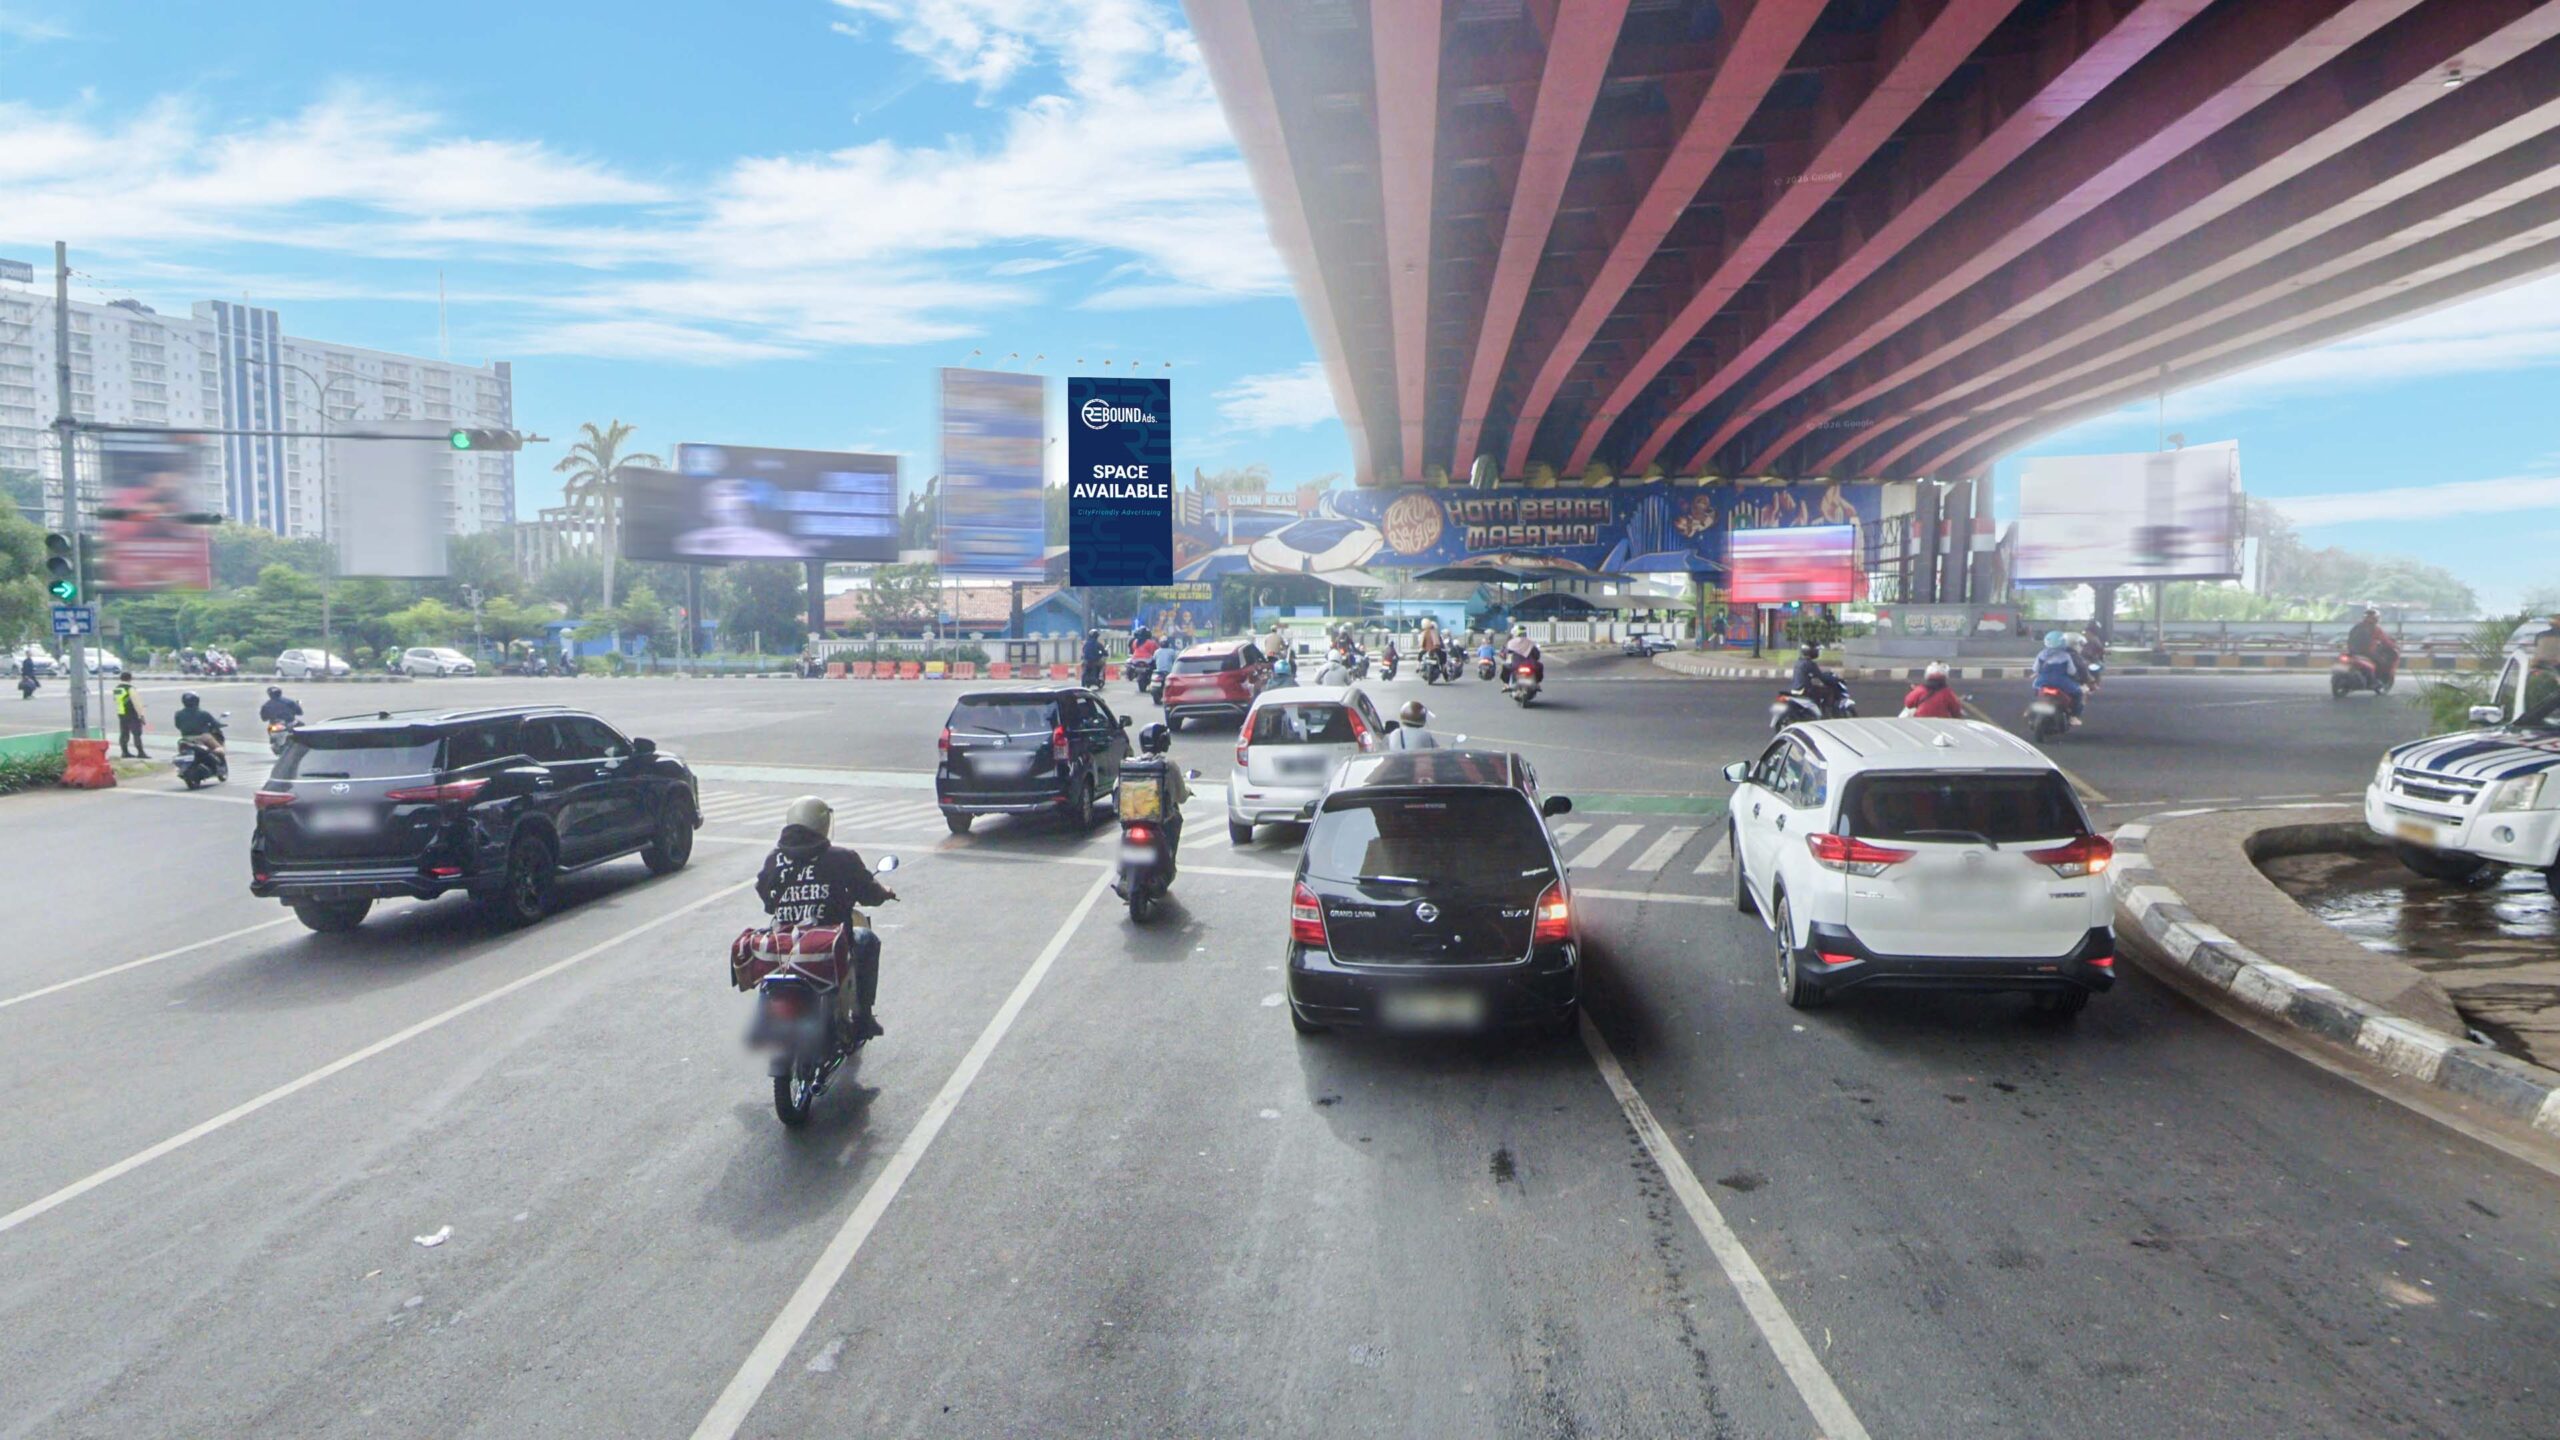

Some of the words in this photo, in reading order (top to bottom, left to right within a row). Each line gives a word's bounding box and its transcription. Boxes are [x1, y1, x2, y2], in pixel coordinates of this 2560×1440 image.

[1082, 404, 1141, 425] REBOUND
[1142, 413, 1158, 423] Ads.
[1093, 465, 1149, 479] SPACE
[1073, 483, 1168, 498] AVAILABLE
[1122, 509, 1162, 517] Advertising
[1520, 498, 1611, 520] BEKASI
[1468, 525, 1543, 548] MASA
[1546, 523, 1596, 545] KINI
